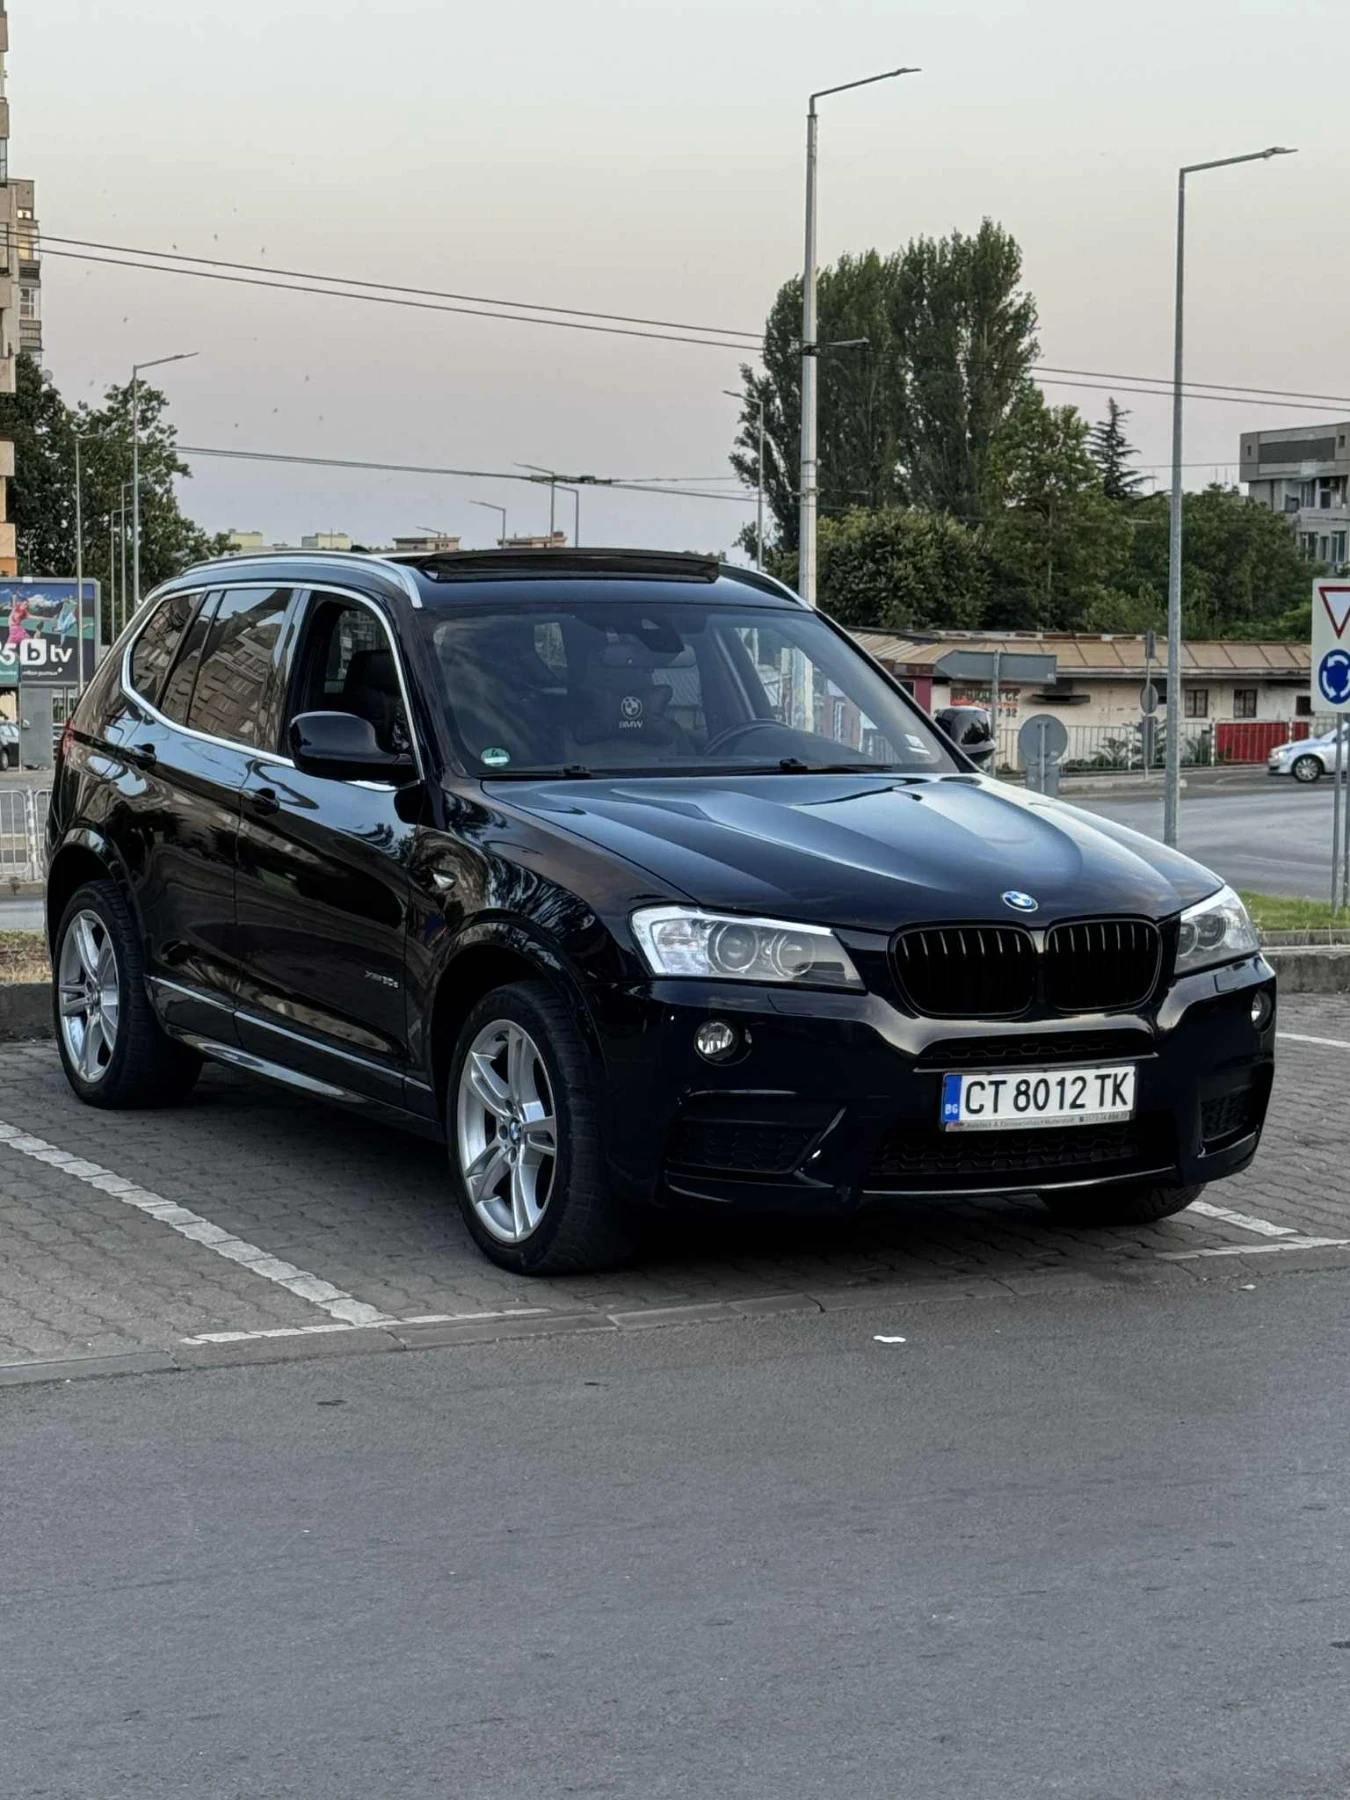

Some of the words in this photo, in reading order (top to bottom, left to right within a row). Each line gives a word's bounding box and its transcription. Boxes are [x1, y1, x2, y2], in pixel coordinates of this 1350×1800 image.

[965, 1080, 1007, 1114] CT
[1013, 1076, 1087, 1112] 8012
[1094, 1072, 1129, 1107] TK
[945, 1104, 958, 1114] BG
